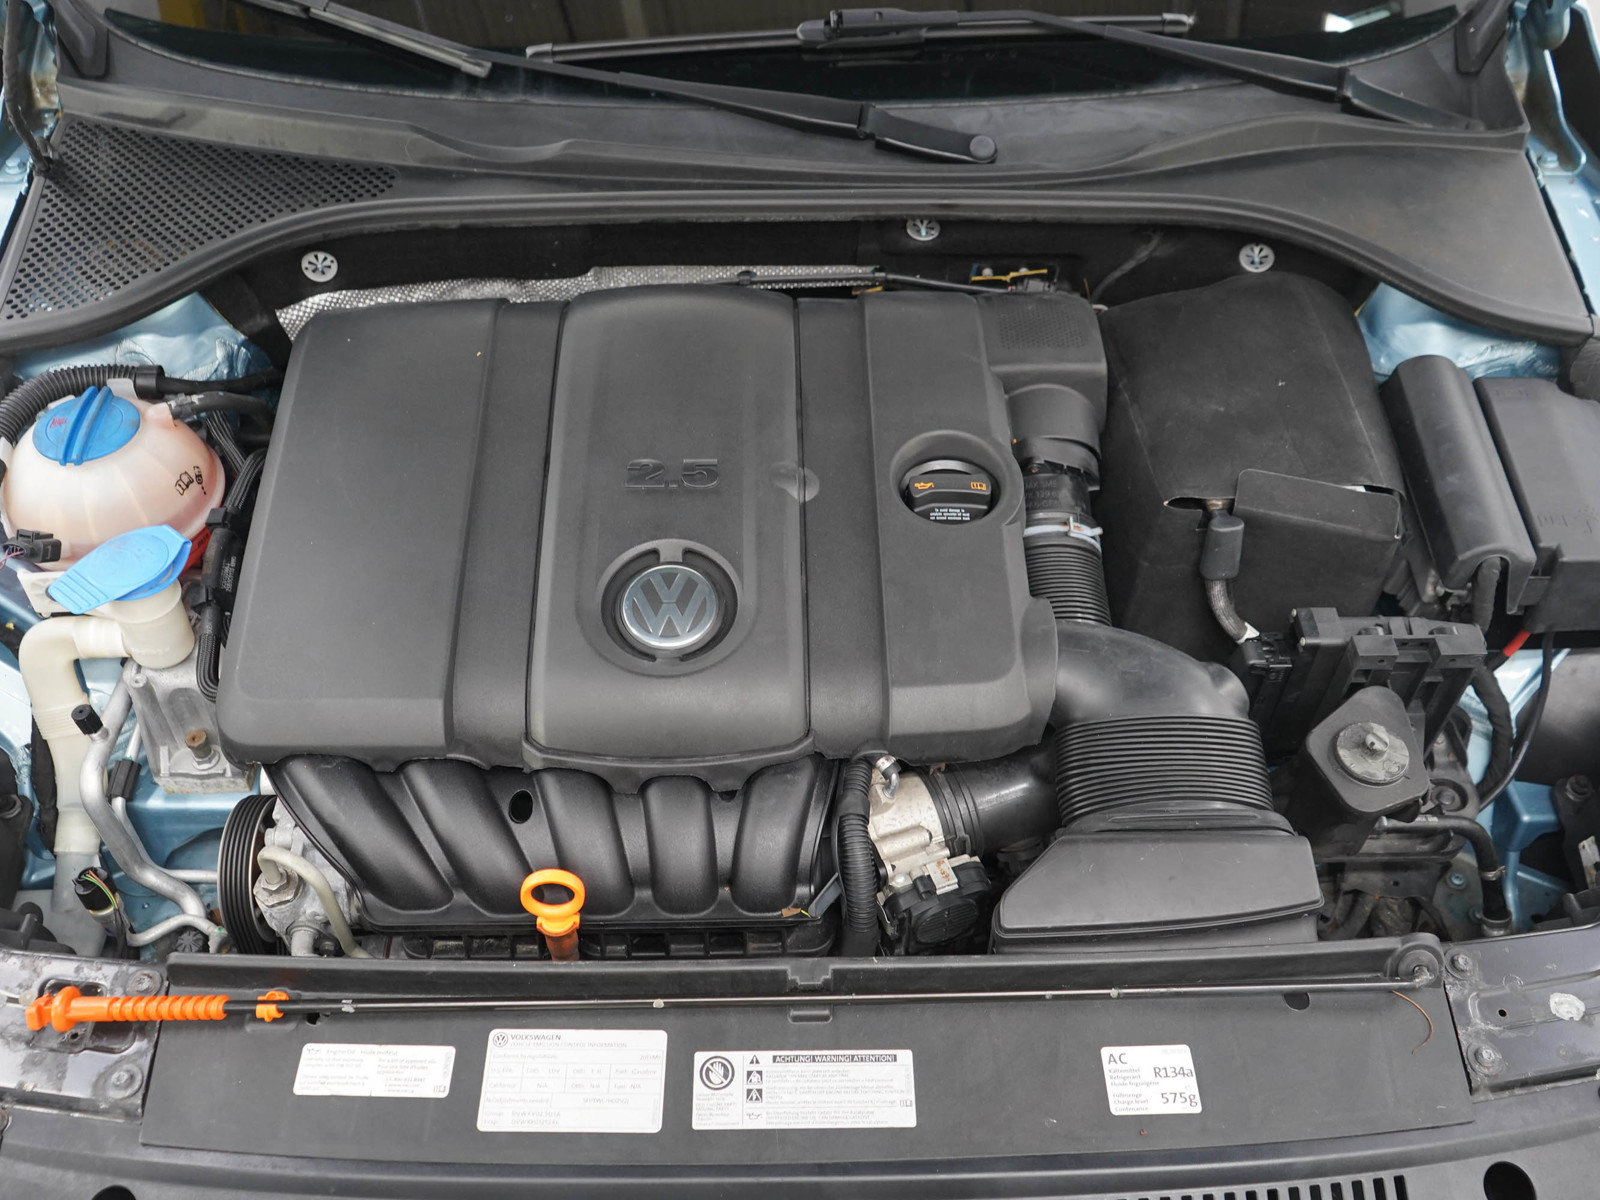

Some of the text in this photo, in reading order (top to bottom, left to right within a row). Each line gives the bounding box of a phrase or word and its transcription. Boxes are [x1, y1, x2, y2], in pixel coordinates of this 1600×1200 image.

[625, 458, 720, 489] 2.5
[775, 1054, 895, 1063] ACHTUNG! WARNING! ATTENTION!
[1108, 1053, 1127, 1065] AC
[1153, 1066, 1194, 1079] R134a
[1161, 1092, 1198, 1108] 575g
